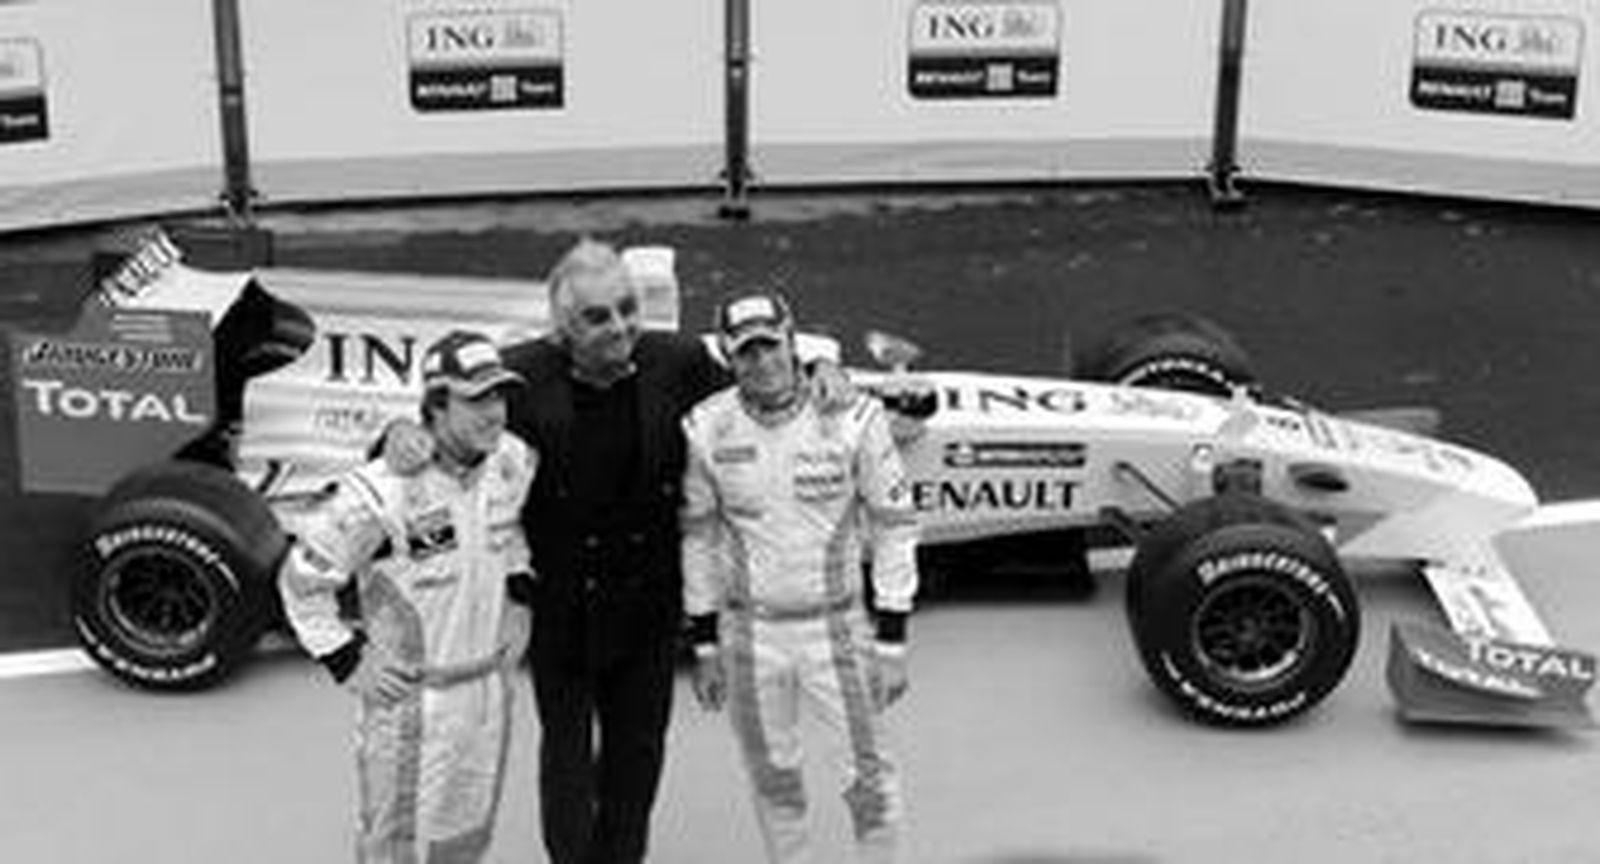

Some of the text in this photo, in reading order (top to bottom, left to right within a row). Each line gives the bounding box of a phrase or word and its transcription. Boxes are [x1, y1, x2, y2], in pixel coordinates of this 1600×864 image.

[426, 26, 494, 51] ING
[928, 15, 995, 39] ING
[1435, 24, 1506, 50] ING
[321, 332, 419, 386] IN
[22, 378, 207, 423] TOTAL
[943, 385, 1087, 413] ING
[911, 478, 1083, 511] ENAULT
[1462, 638, 1595, 681] TOTAL
